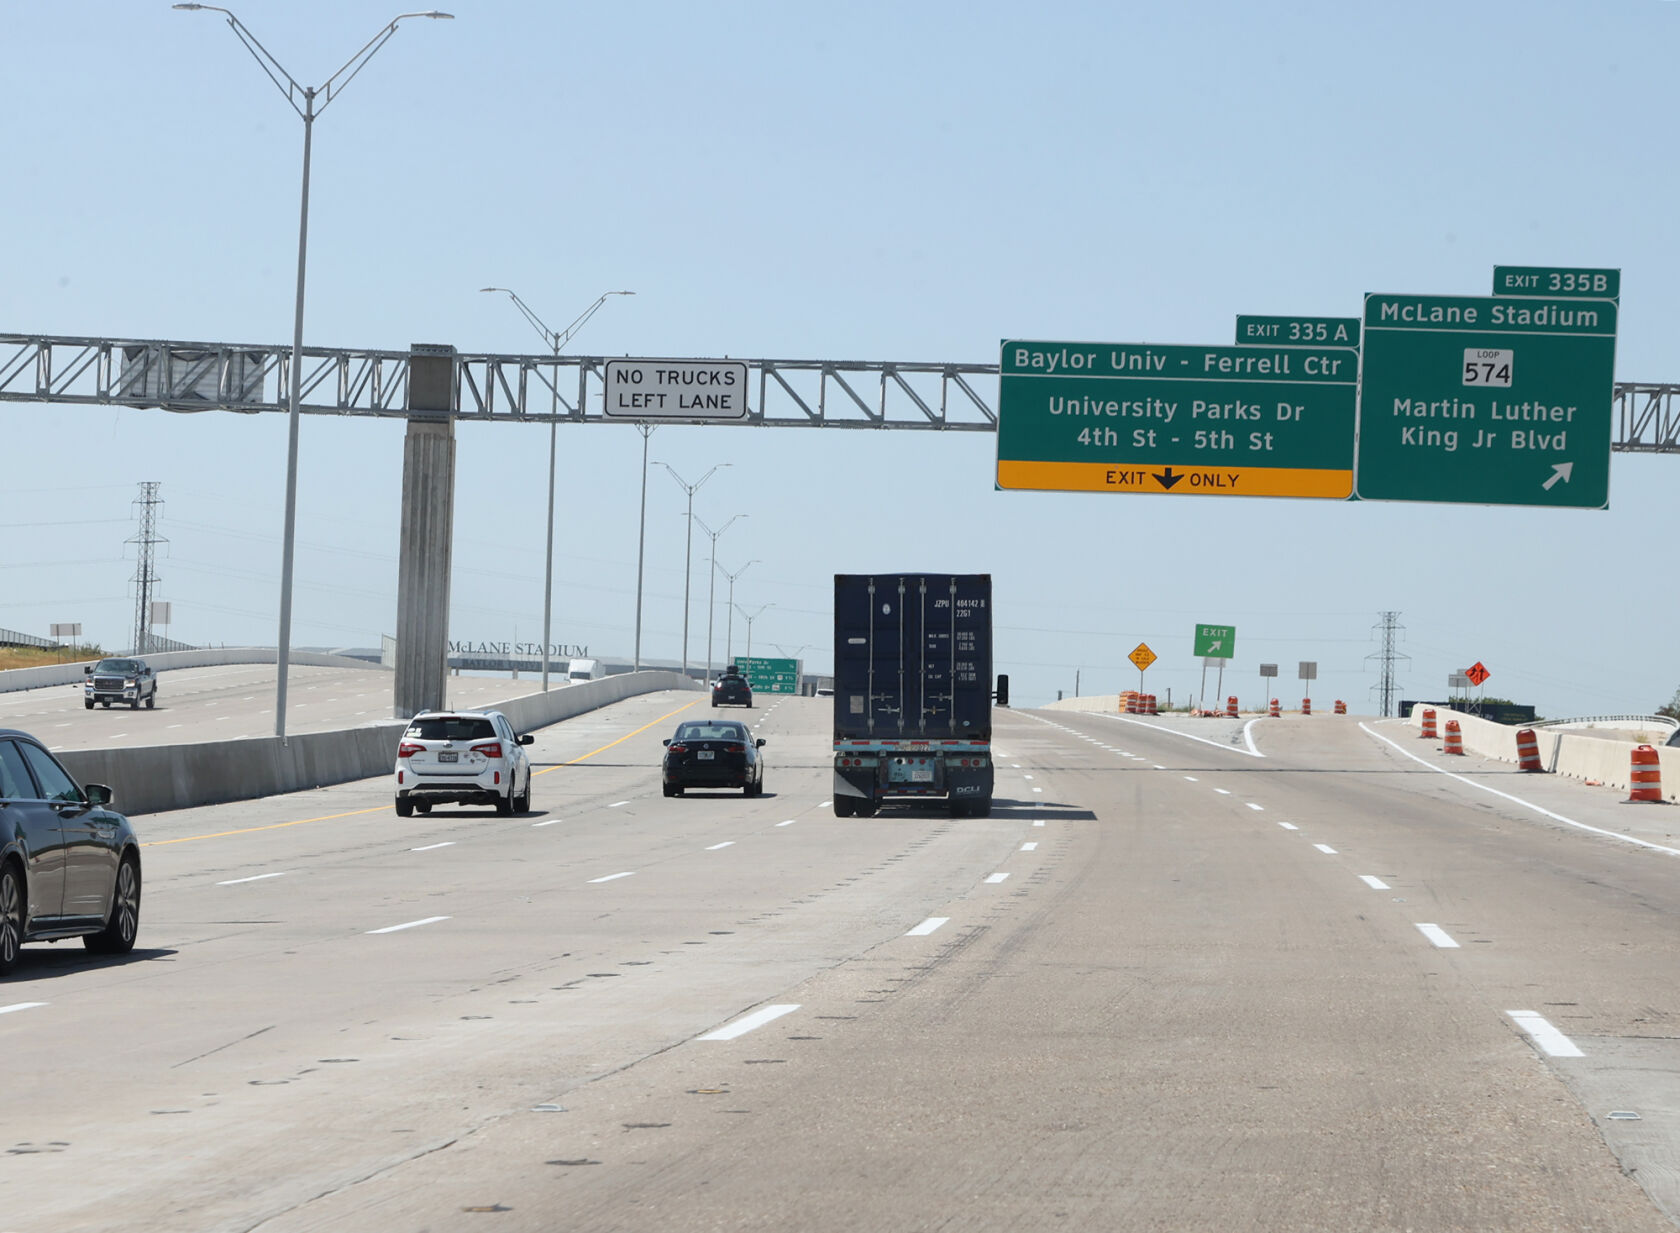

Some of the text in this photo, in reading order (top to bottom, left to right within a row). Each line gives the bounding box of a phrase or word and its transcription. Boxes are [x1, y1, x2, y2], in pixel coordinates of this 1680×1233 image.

[1505, 273, 1608, 292] EXIT 335B
[1380, 302, 1598, 327] McLane Stadium
[1247, 324, 1280, 337] EXIT
[1288, 322, 1328, 341] 335
[1014, 349, 1097, 373] Baylor
[1111, 350, 1167, 371] Univ
[1204, 353, 1290, 374] Ferrell
[1303, 356, 1342, 375] Ctr
[1477, 351, 1500, 359] LOOP
[616, 369, 735, 386] NO TRUCKS
[1465, 362, 1510, 384] 574
[619, 393, 731, 409] LEFT LANE
[1049, 396, 1305, 423] University Parks Dr
[1393, 398, 1577, 422] Martin Luther
[1077, 427, 1118, 446] 4th
[1132, 429, 1157, 448] St
[1194, 430, 1234, 449] 5th
[1249, 432, 1274, 450] St
[1401, 426, 1567, 452] King Jr Blvd
[1106, 471, 1240, 488] EXIT ONLY
[1202, 628, 1228, 637] EXIT
[448, 640, 589, 658] McLANE STADIUM
